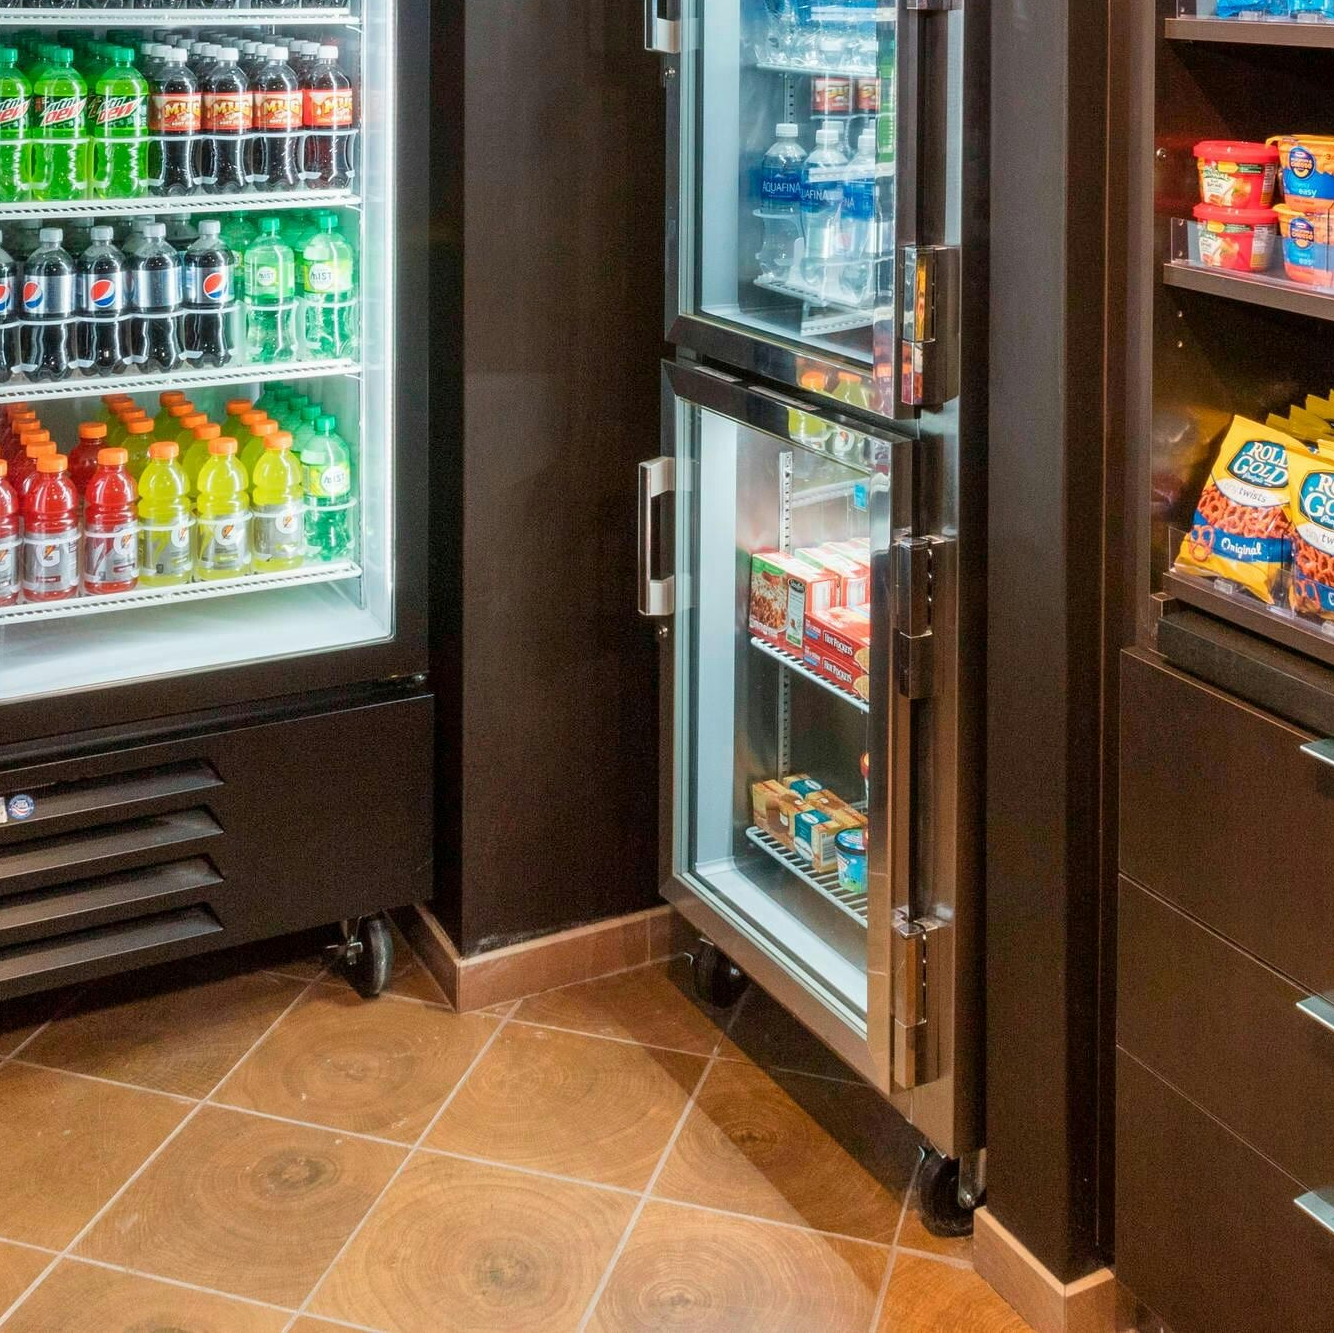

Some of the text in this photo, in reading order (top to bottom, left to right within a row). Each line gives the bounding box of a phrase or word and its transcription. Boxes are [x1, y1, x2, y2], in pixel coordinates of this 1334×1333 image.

[165, 102, 201, 117] MUG
[213, 101, 251, 116] MUG
[264, 100, 301, 115] MUG
[763, 181, 801, 194] AQUAFINA
[1298, 188, 1317, 198] easy
[1233, 455, 1289, 485] GOLD
[1238, 486, 1267, 503] twists
[1221, 537, 1262, 558] Original
[833, 637, 854, 656] POCKETS
